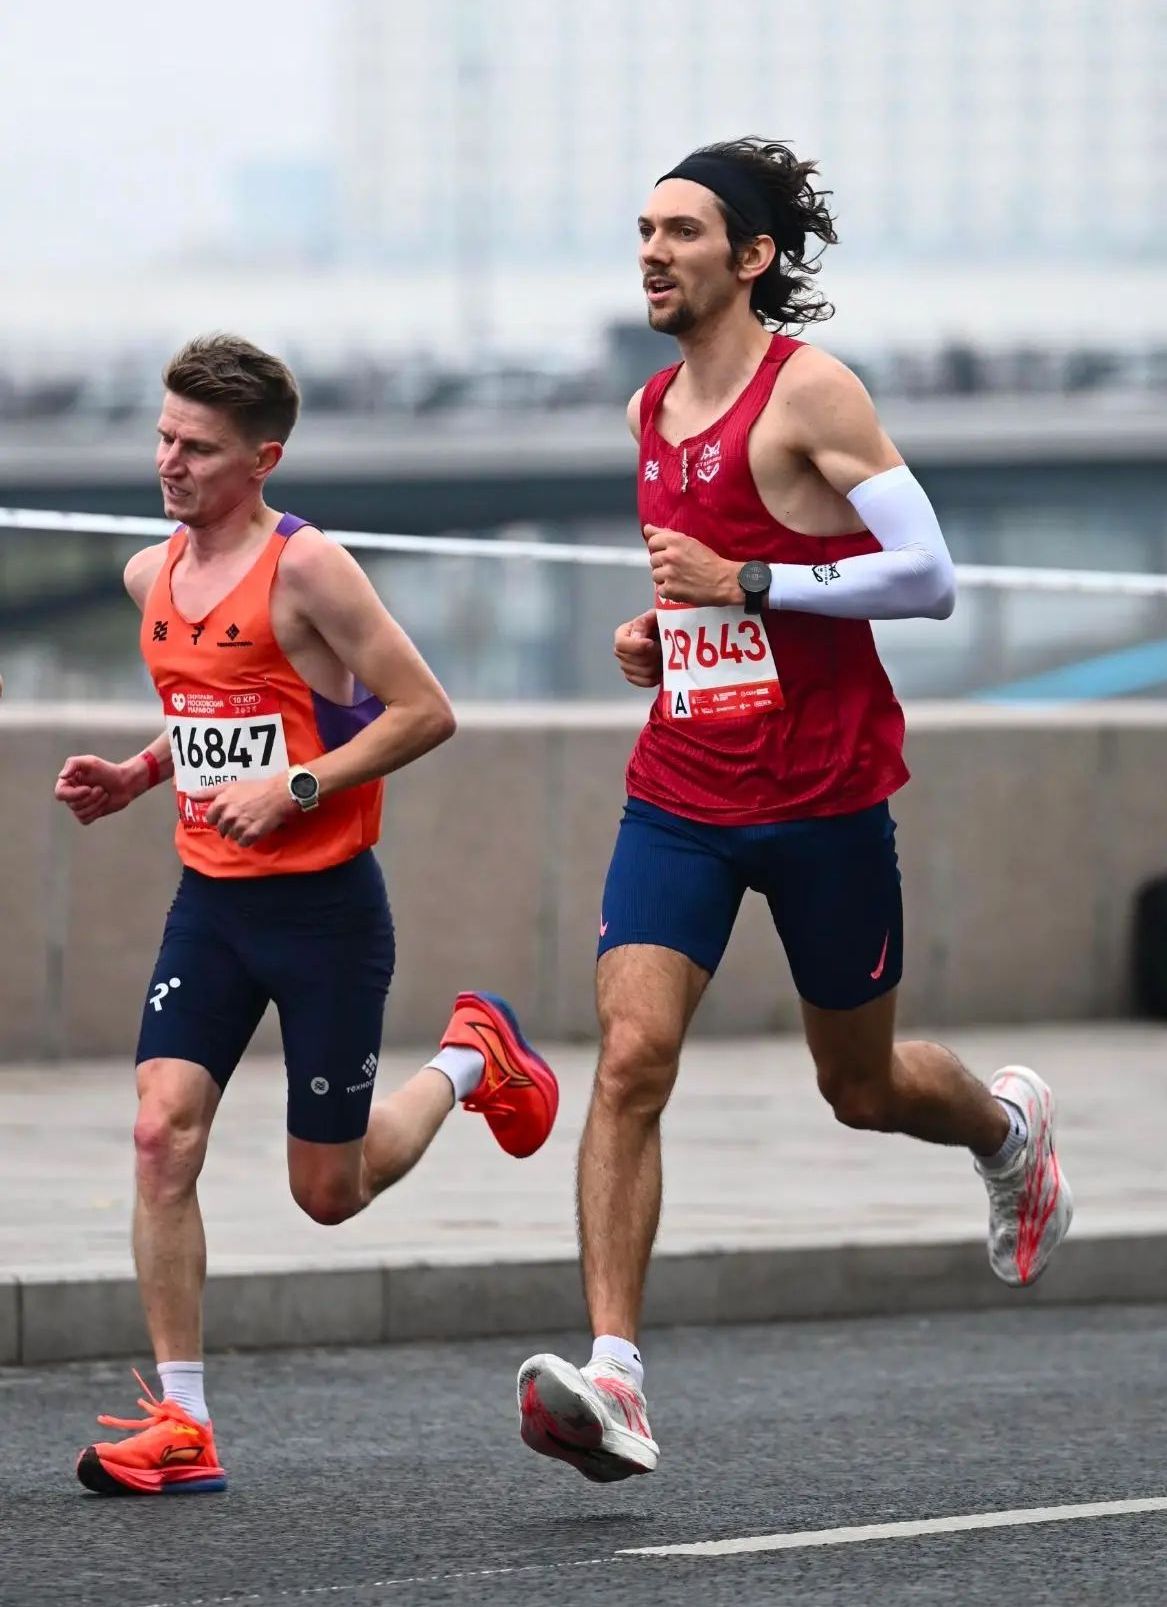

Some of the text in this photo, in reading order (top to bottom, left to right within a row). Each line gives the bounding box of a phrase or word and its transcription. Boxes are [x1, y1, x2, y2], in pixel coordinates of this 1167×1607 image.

[663, 620, 767, 670] 29643
[233, 696, 242, 704] 10
[674, 691, 688, 714] A
[172, 723, 277, 769] 16847
